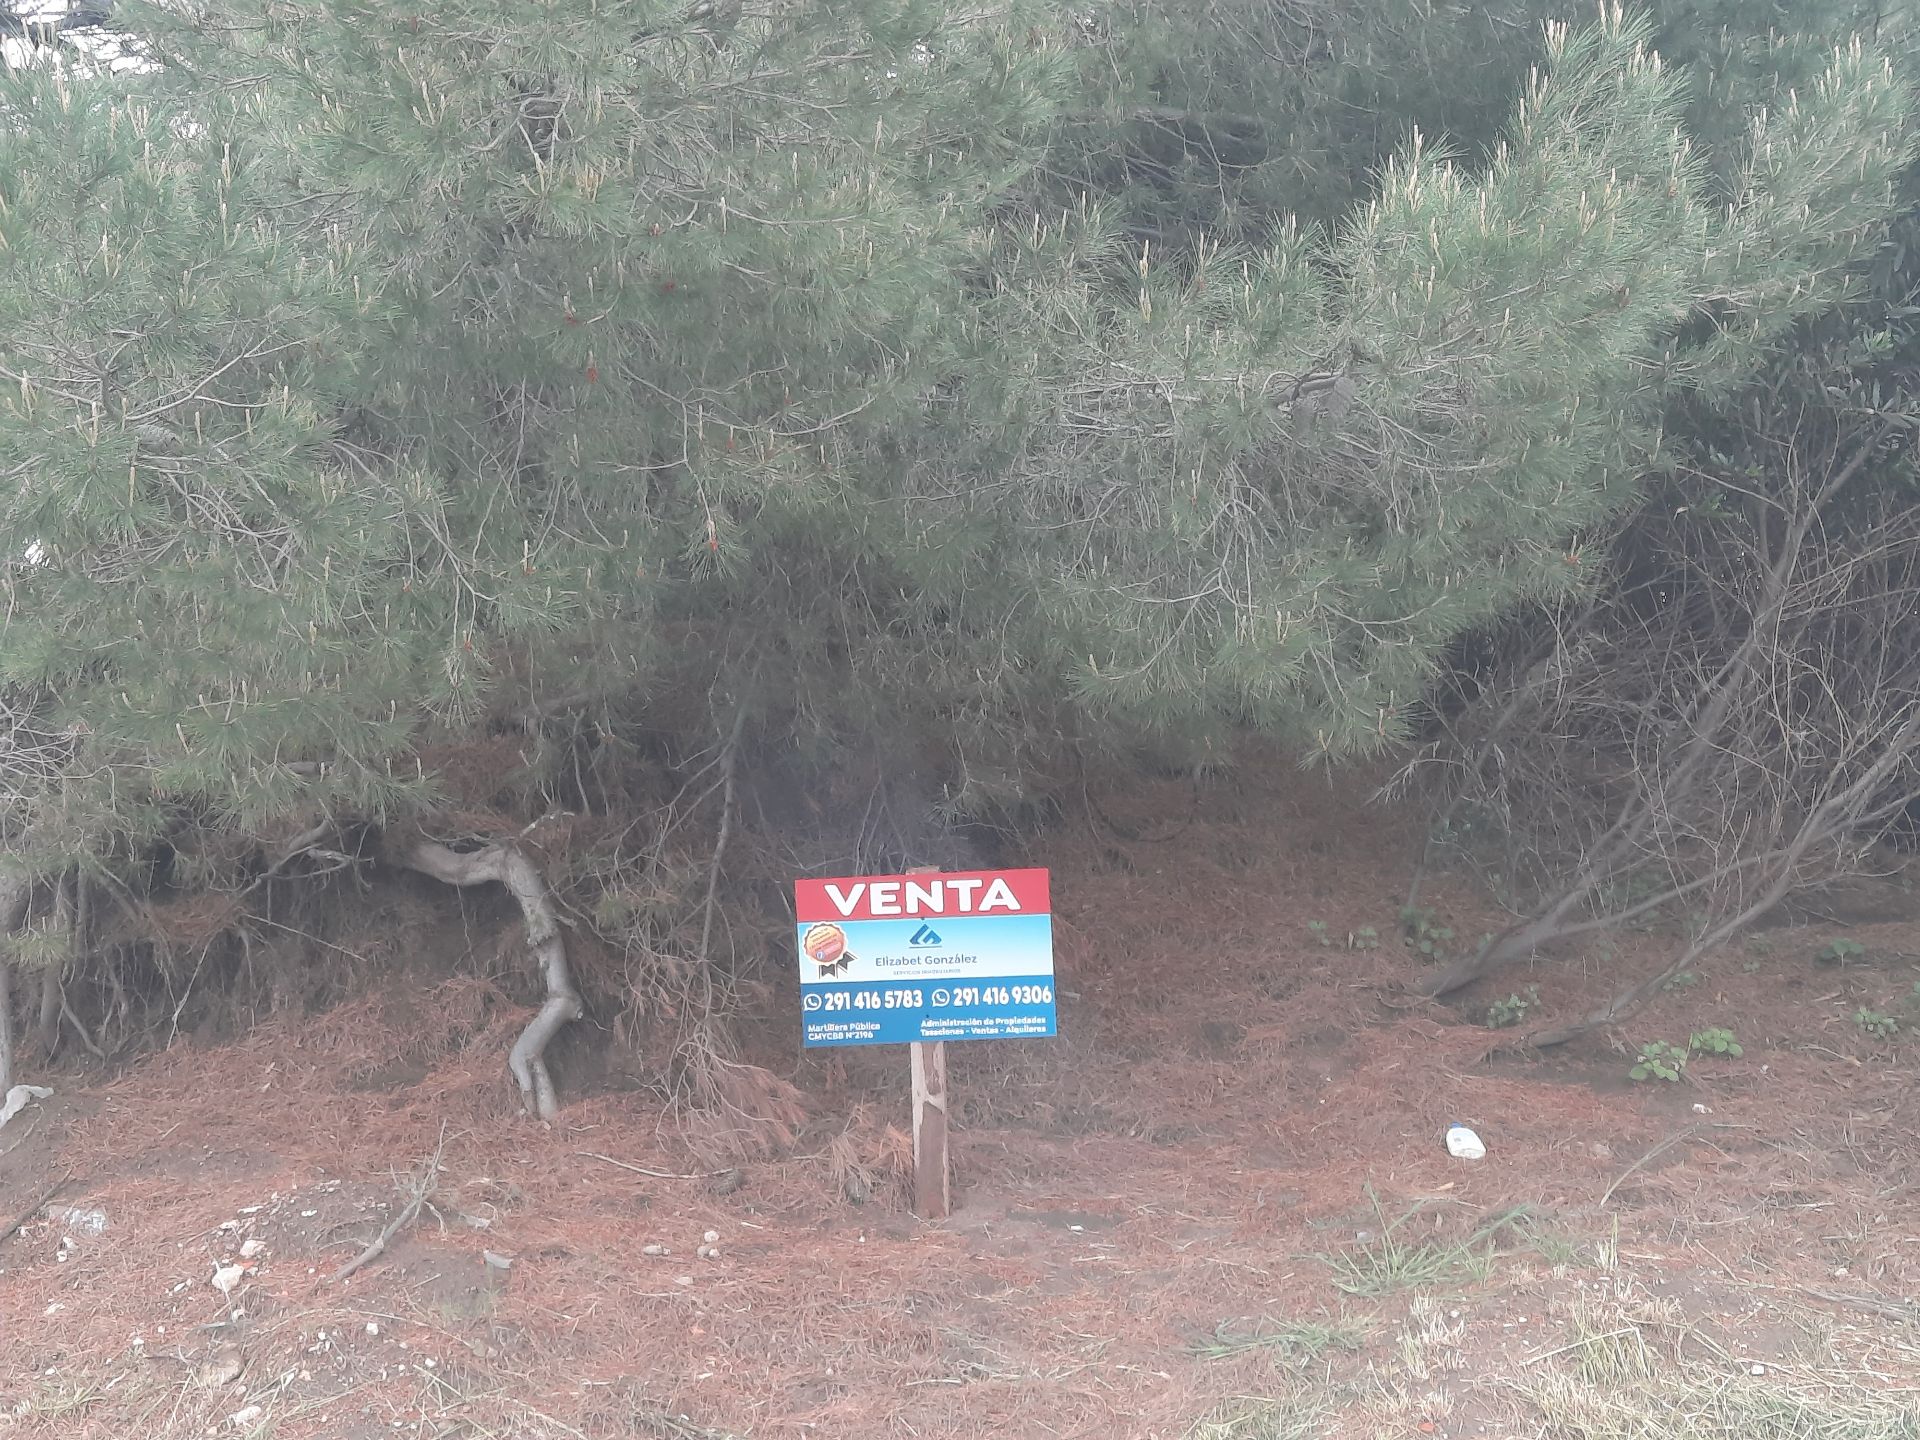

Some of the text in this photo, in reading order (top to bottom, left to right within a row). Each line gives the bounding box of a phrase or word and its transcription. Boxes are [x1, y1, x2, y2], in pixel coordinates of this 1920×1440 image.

[824, 878, 1022, 917] VENTA
[875, 953, 978, 967] Elizabet González
[824, 989, 924, 1011] 291 416 5783
[953, 985, 1053, 1007] 291 416 9306
[849, 1021, 881, 1031] Pública
[920, 1016, 1046, 1028] Administración de Propiedades
[920, 1027, 965, 1036] Tasaciones
[970, 1026, 999, 1035] Ventas
[1005, 1025, 1047, 1035] Alquileres
